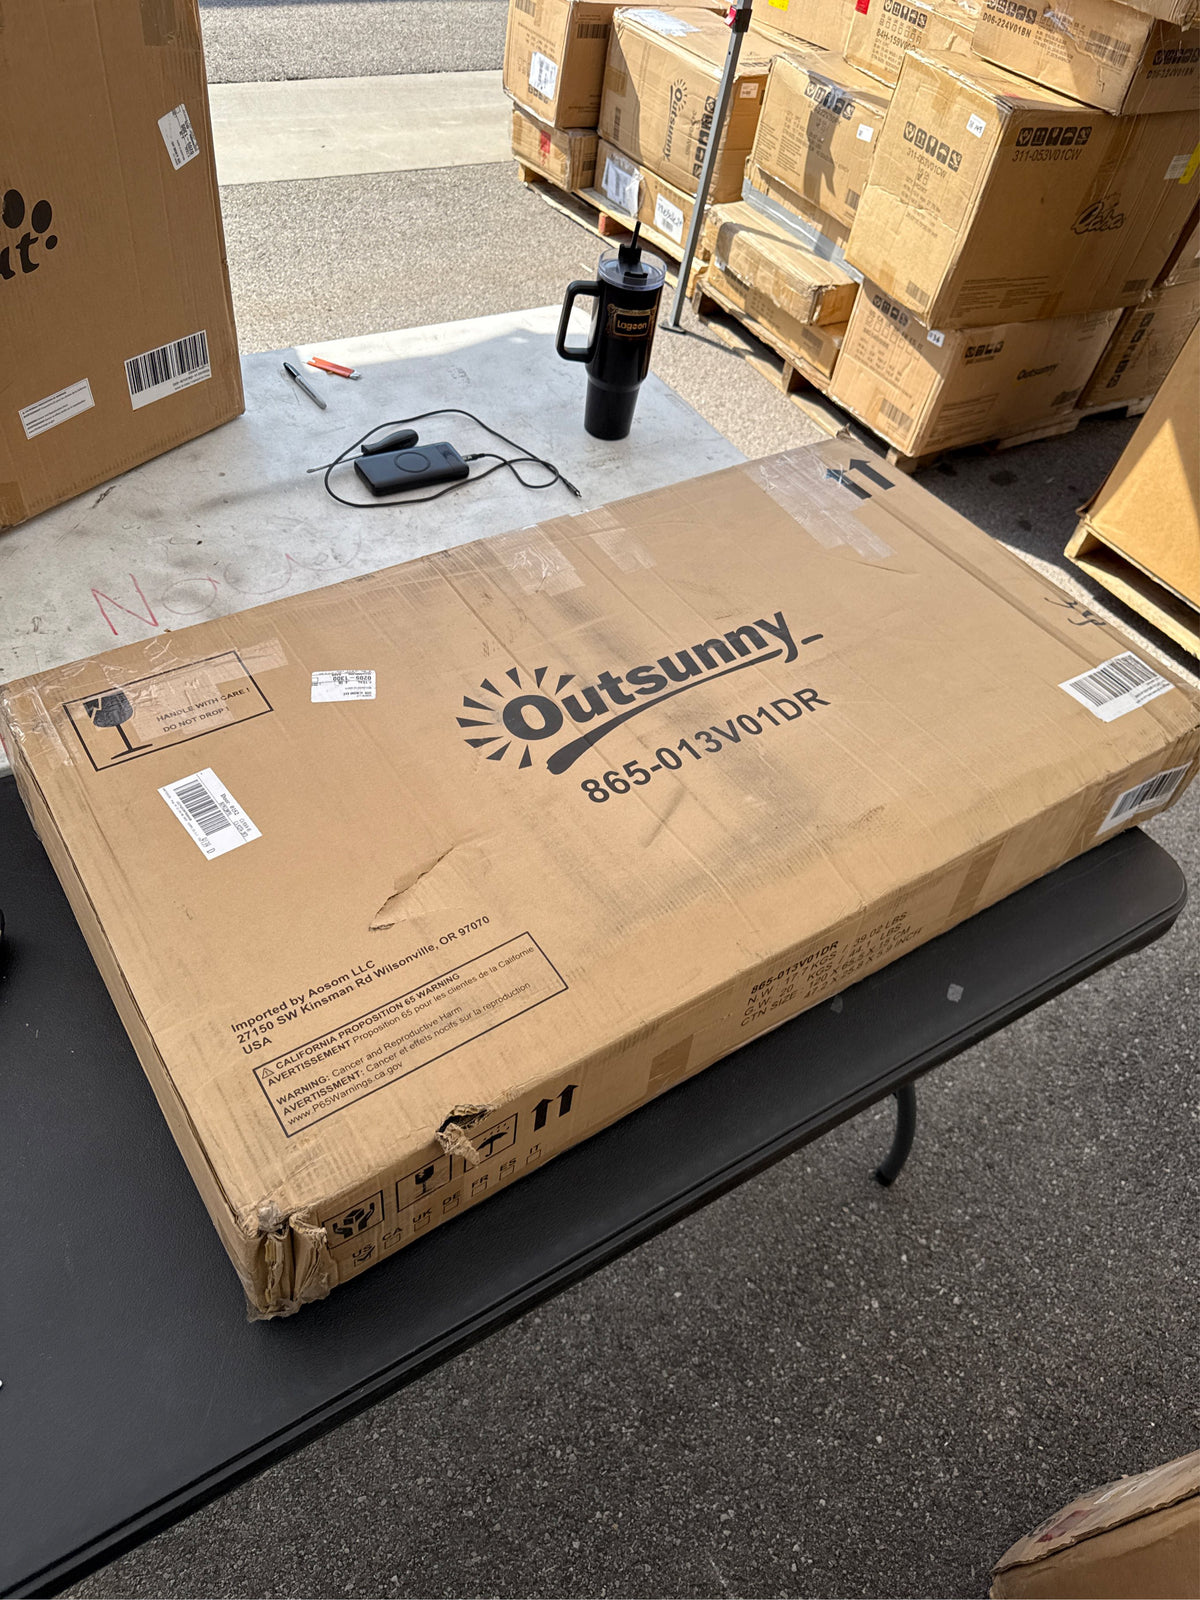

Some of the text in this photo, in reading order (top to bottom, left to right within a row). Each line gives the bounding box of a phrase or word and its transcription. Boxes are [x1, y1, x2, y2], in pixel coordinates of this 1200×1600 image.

[982, 13, 1032, 38] D06-224V01BN
[1012, 150, 1082, 162] 311-053V01CW
[503, 611, 799, 741] Outsunny
[156, 706, 194, 722] HANDLE
[195, 698, 219, 709] WITH
[220, 689, 245, 701] CARE
[163, 723, 177, 733] DO
[178, 717, 197, 727] NOT
[200, 708, 224, 720] DROP
[581, 688, 831, 803] 865-013V01DR
[741, 1008, 767, 1027] CTN
[810, 974, 828, 989] 120
[891, 926, 911, 941] CM
[751, 941, 839, 995] 865-013V01DR
[809, 951, 838, 970] KGS
[237, 915, 490, 1044] 27150 SW Kinsman Rd Wilsonville, OR 97070
[780, 984, 794, 998] 20
[806, 965, 831, 982] KGS
[231, 960, 376, 1033] Imported by Aosom LLC
[268, 1040, 351, 1087] AVERTISSEMENT
[352, 1016, 401, 1044] Proposition
[401, 1009, 413, 1019] 65
[414, 1000, 437, 1014] pour
[478, 971, 489, 979] de
[490, 965, 498, 973] la
[498, 945, 535, 968] Californie
[276, 973, 460, 1069] CALIFORNIA PROPOSITION 65 WARNING
[243, 1036, 272, 1055] USA
[276, 1006, 463, 1106] WARNING: Cancer and Reproductive Harm
[283, 981, 531, 1117] AVERTISSMENT: Cancer et effets nocifs sur la reproduction
[287, 1061, 404, 1127] www.P65Warnings.ca.gov
[500, 1157, 516, 1171] ES
[529, 1143, 542, 1154] IT
[442, 1190, 461, 1205] DE
[471, 1173, 489, 1189] FR
[412, 1208, 433, 1224] UK
[382, 1226, 403, 1241] CA
